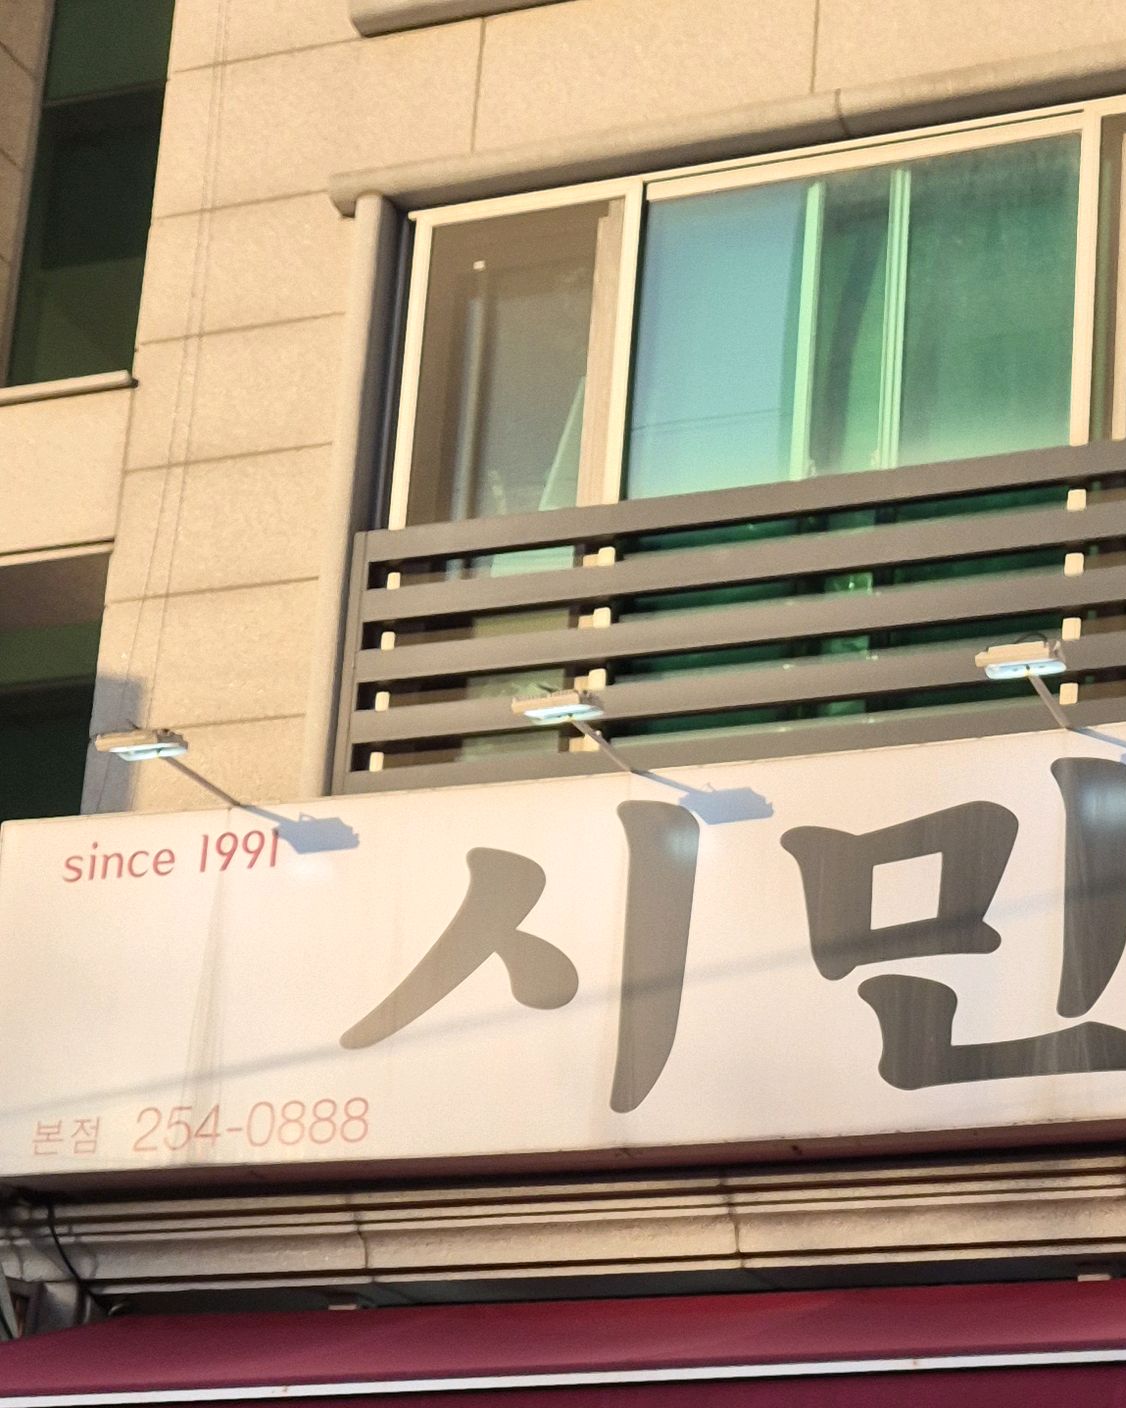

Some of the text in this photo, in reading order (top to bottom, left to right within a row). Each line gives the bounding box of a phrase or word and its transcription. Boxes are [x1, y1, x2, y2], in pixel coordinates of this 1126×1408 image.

[62, 830, 279, 883] since 1991
[32, 1097, 369, 1156] 본점 254-0888
